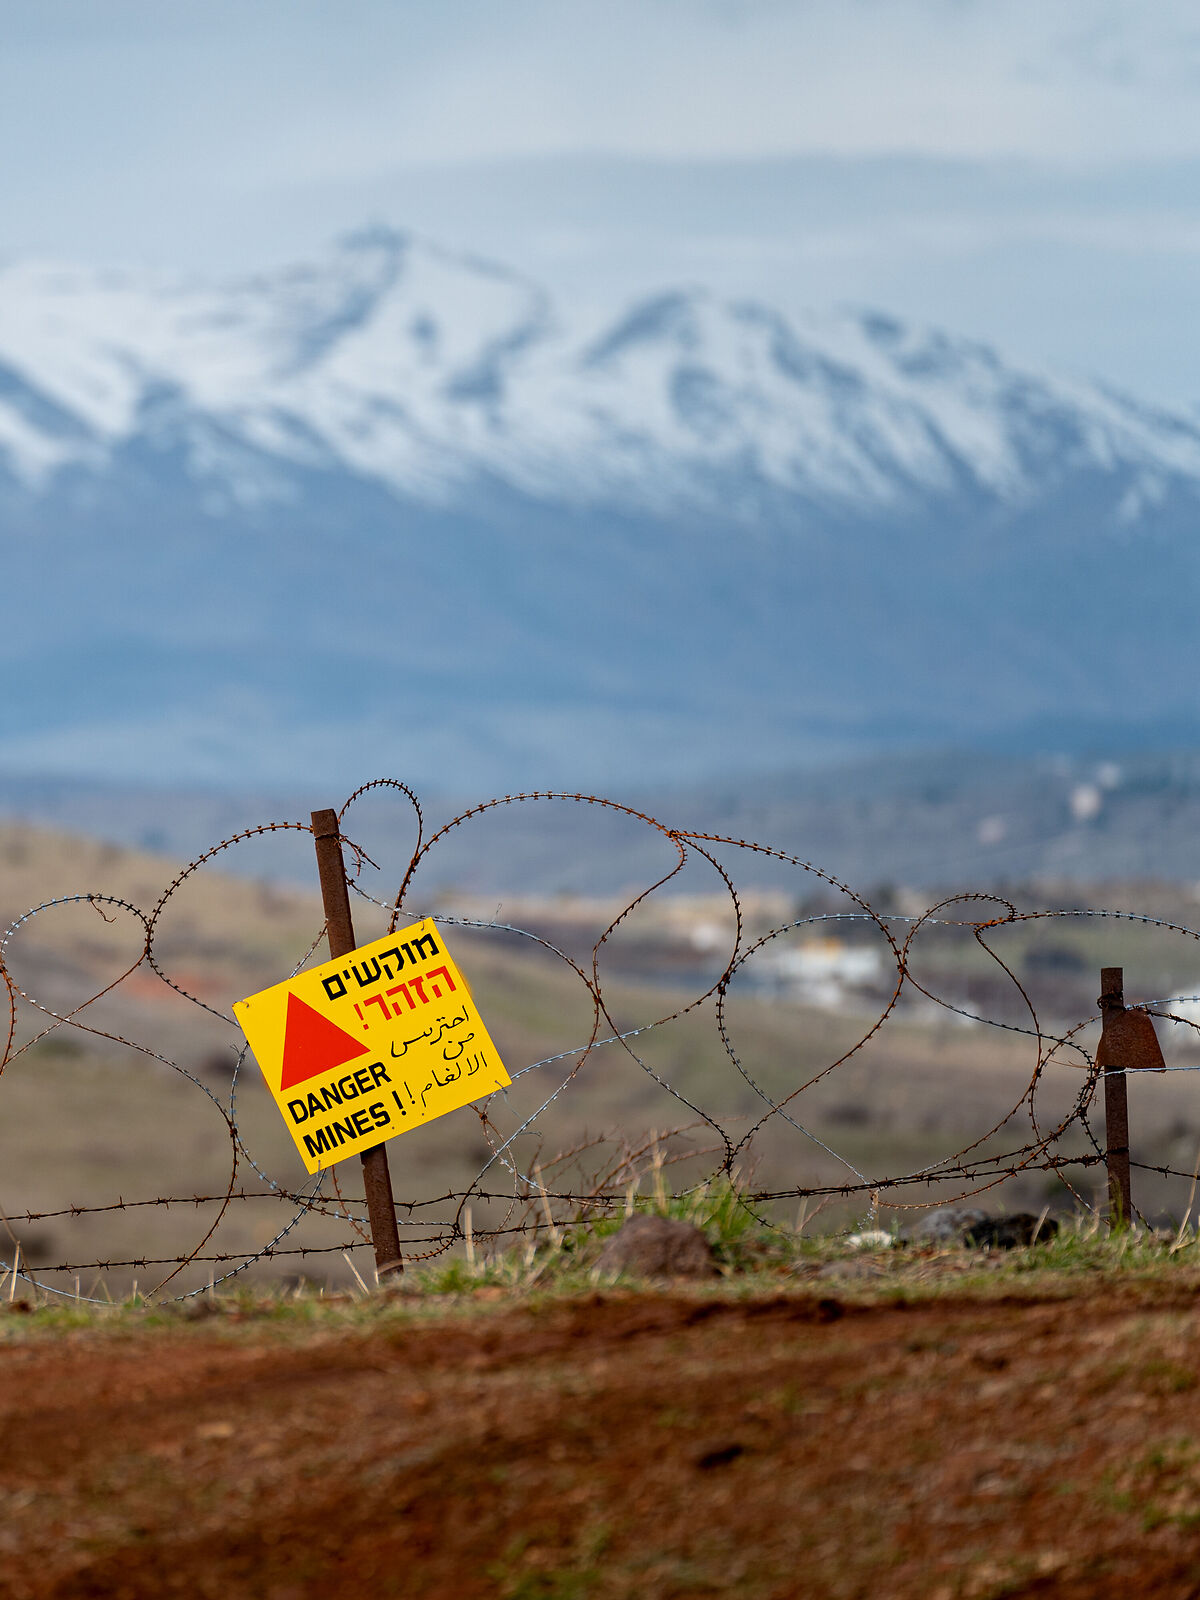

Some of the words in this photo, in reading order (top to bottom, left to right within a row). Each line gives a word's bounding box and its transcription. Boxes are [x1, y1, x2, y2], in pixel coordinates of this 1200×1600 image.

[321, 933, 440, 1001] מוקשים
[442, 1032, 475, 1060] من
[287, 1061, 392, 1125] DANGER
